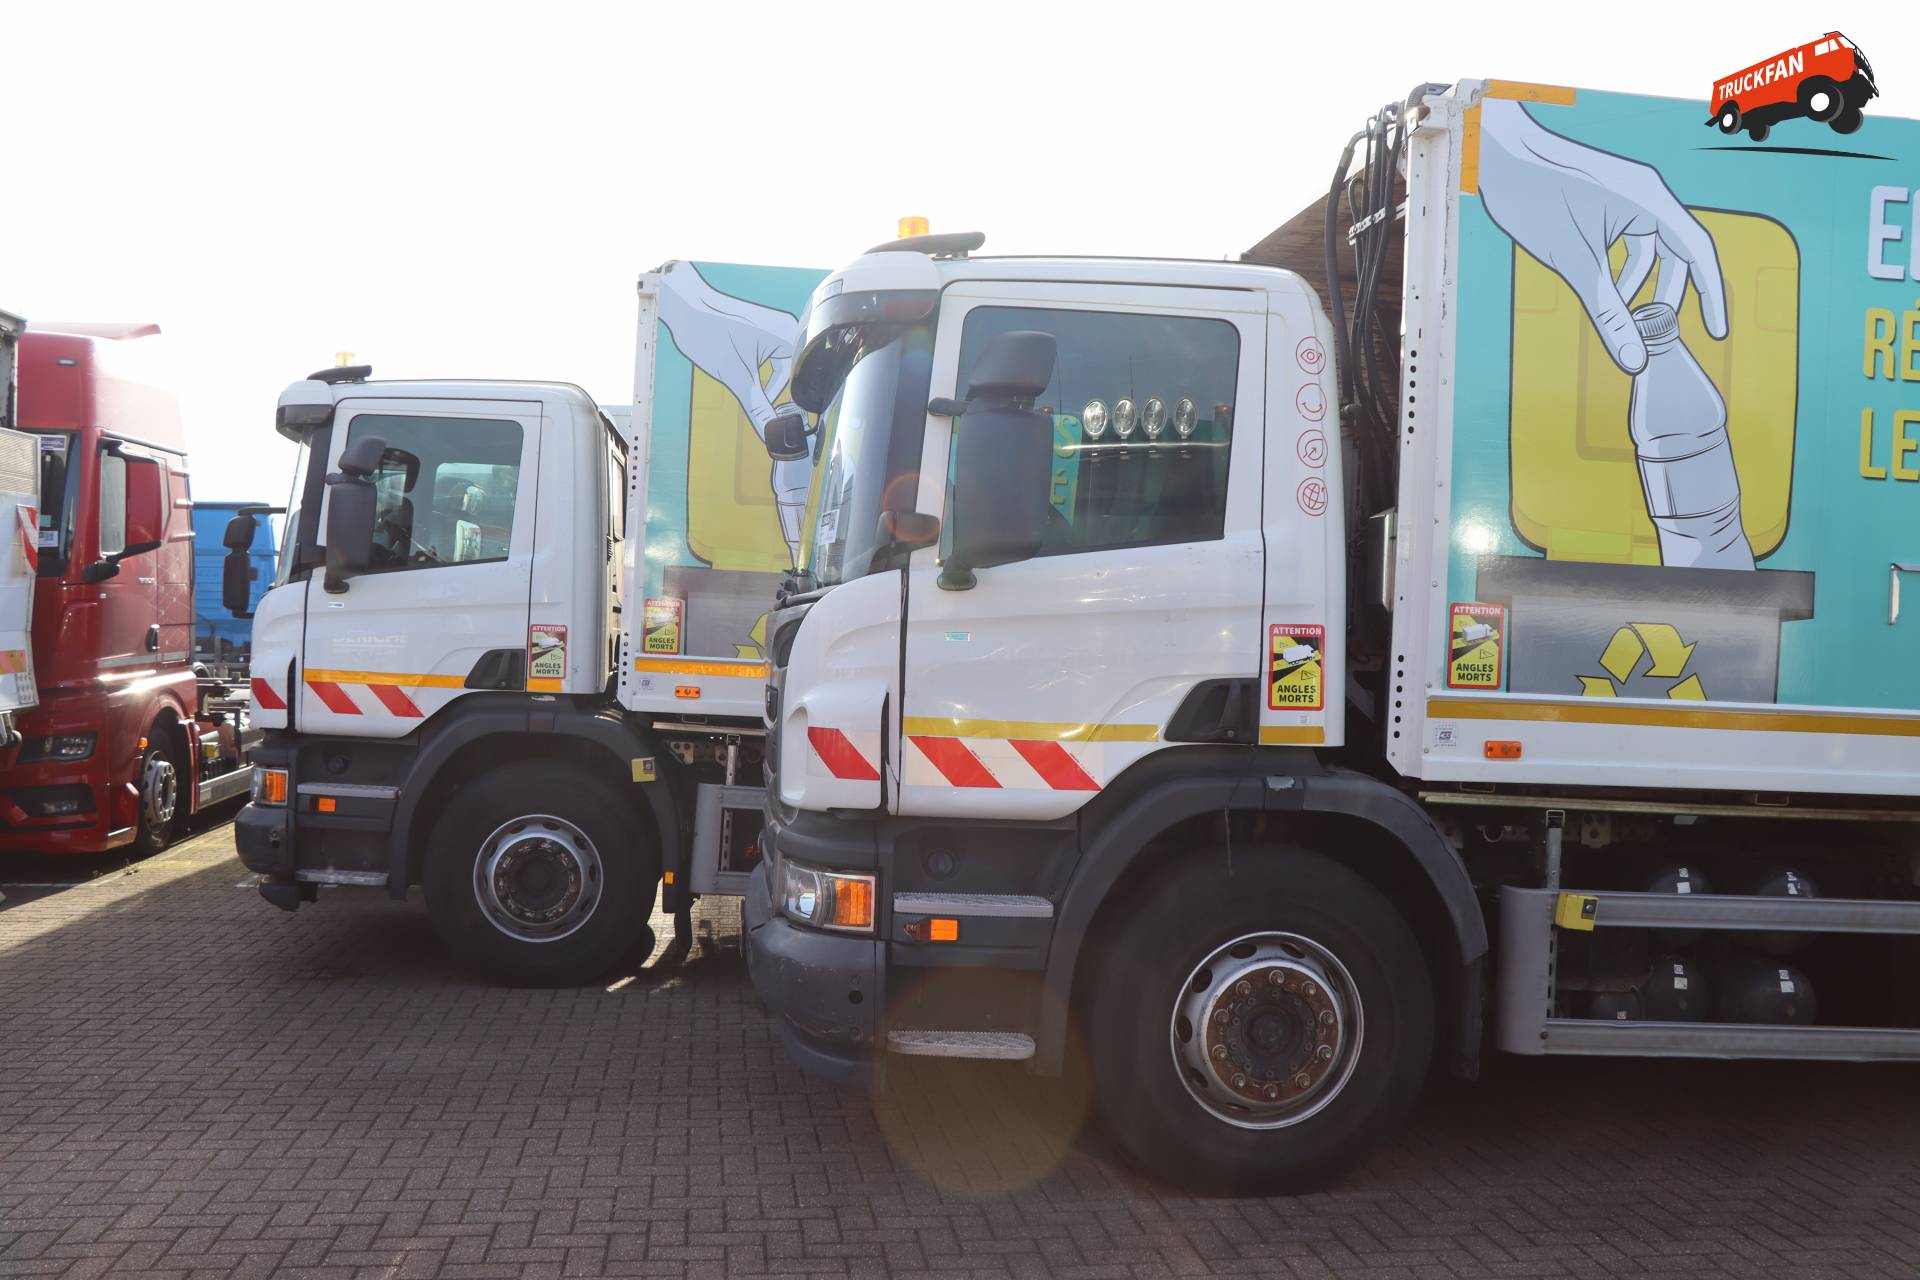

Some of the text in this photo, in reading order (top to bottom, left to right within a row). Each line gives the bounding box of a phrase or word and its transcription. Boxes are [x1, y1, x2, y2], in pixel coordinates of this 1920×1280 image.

[1454, 605, 1502, 615] ATTENTION
[1273, 627, 1322, 635] ATTENTION
[1456, 663, 1494, 673] ANGLES
[1458, 672, 1492, 681] MORTS
[1277, 685, 1316, 694] ANGLES
[1279, 694, 1314, 703] MORTS
